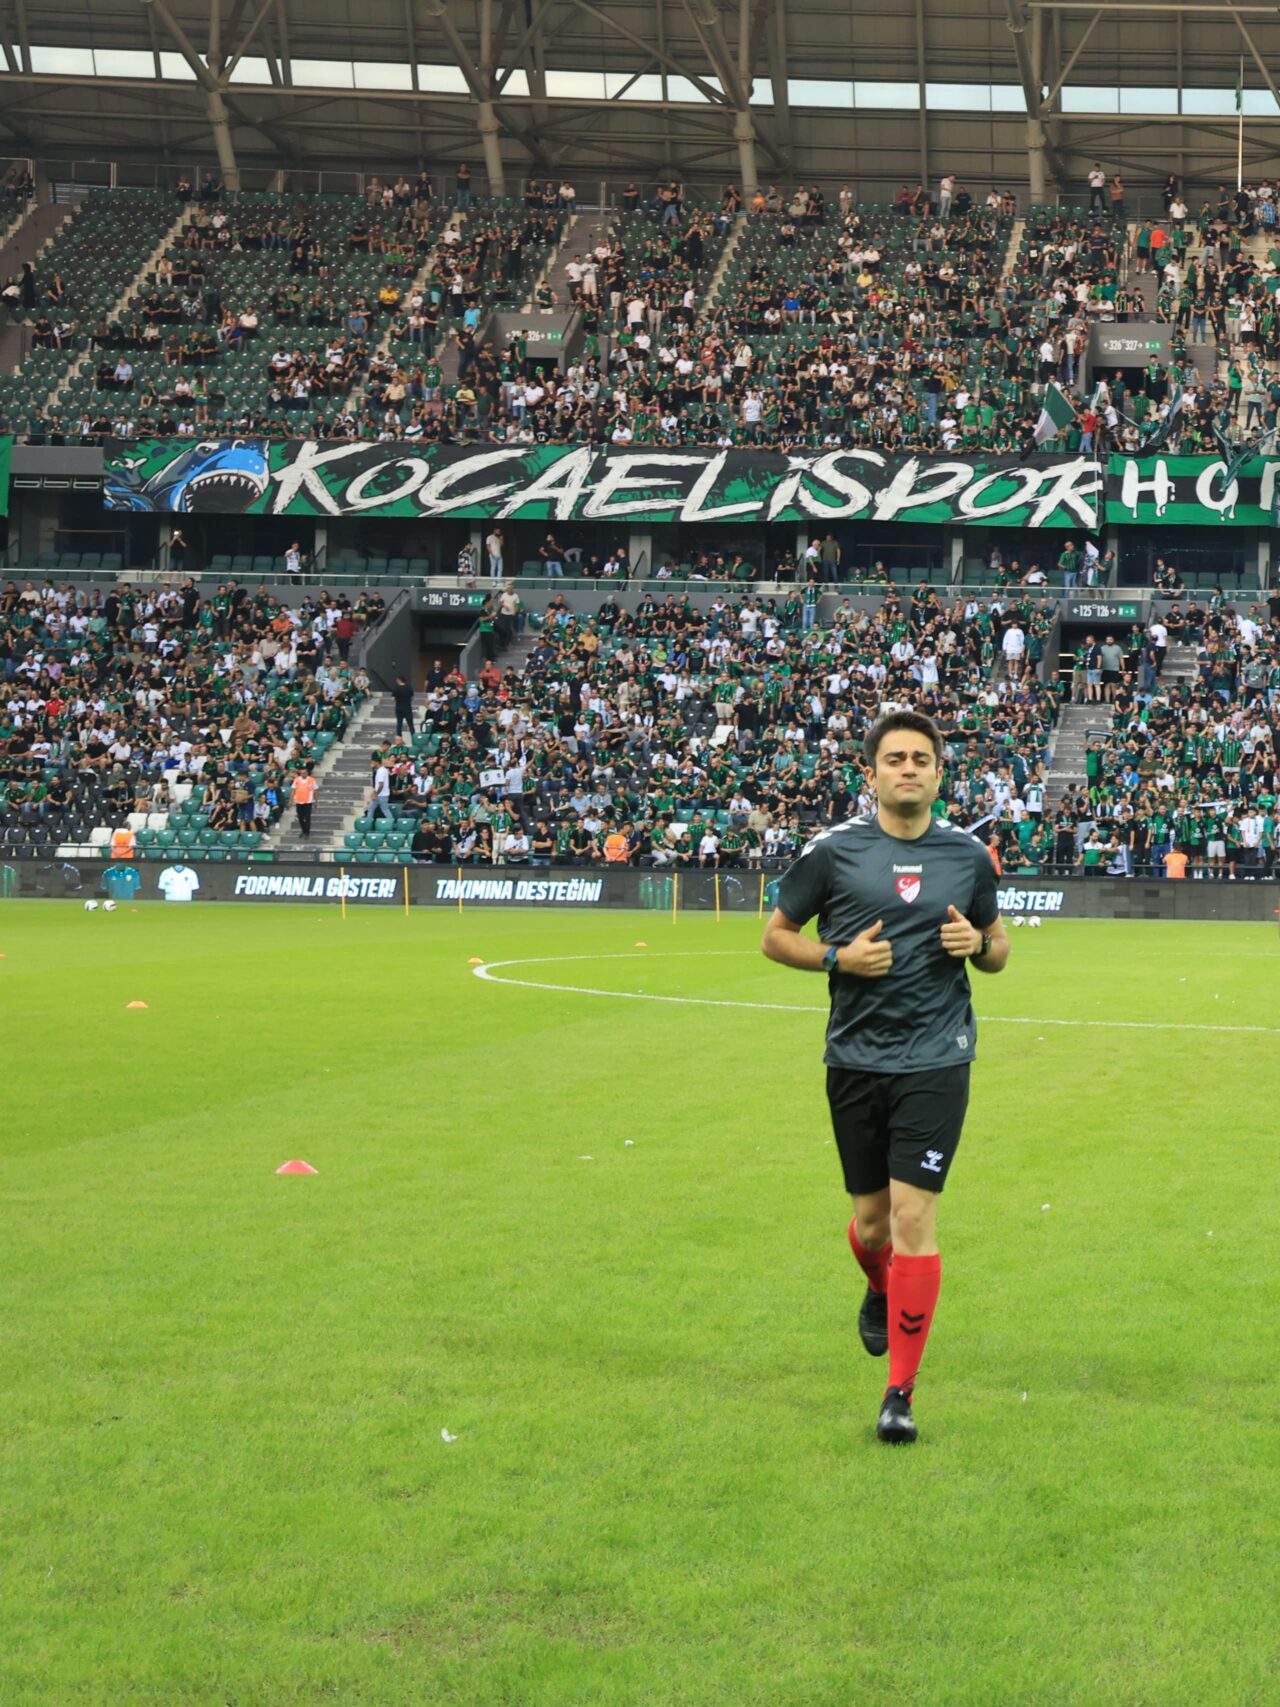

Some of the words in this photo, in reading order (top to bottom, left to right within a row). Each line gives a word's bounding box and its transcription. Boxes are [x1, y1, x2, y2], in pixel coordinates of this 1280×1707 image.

[1079, 605, 1093, 617] 125
[1097, 605, 1110, 618] 126
[235, 875, 324, 896] FORMANLA
[325, 874, 397, 898] GÖSTER!
[436, 879, 512, 900] TAKIMINA
[514, 878, 603, 902] DESTEĞİNİ
[996, 887, 1064, 911] GÖSTER!
